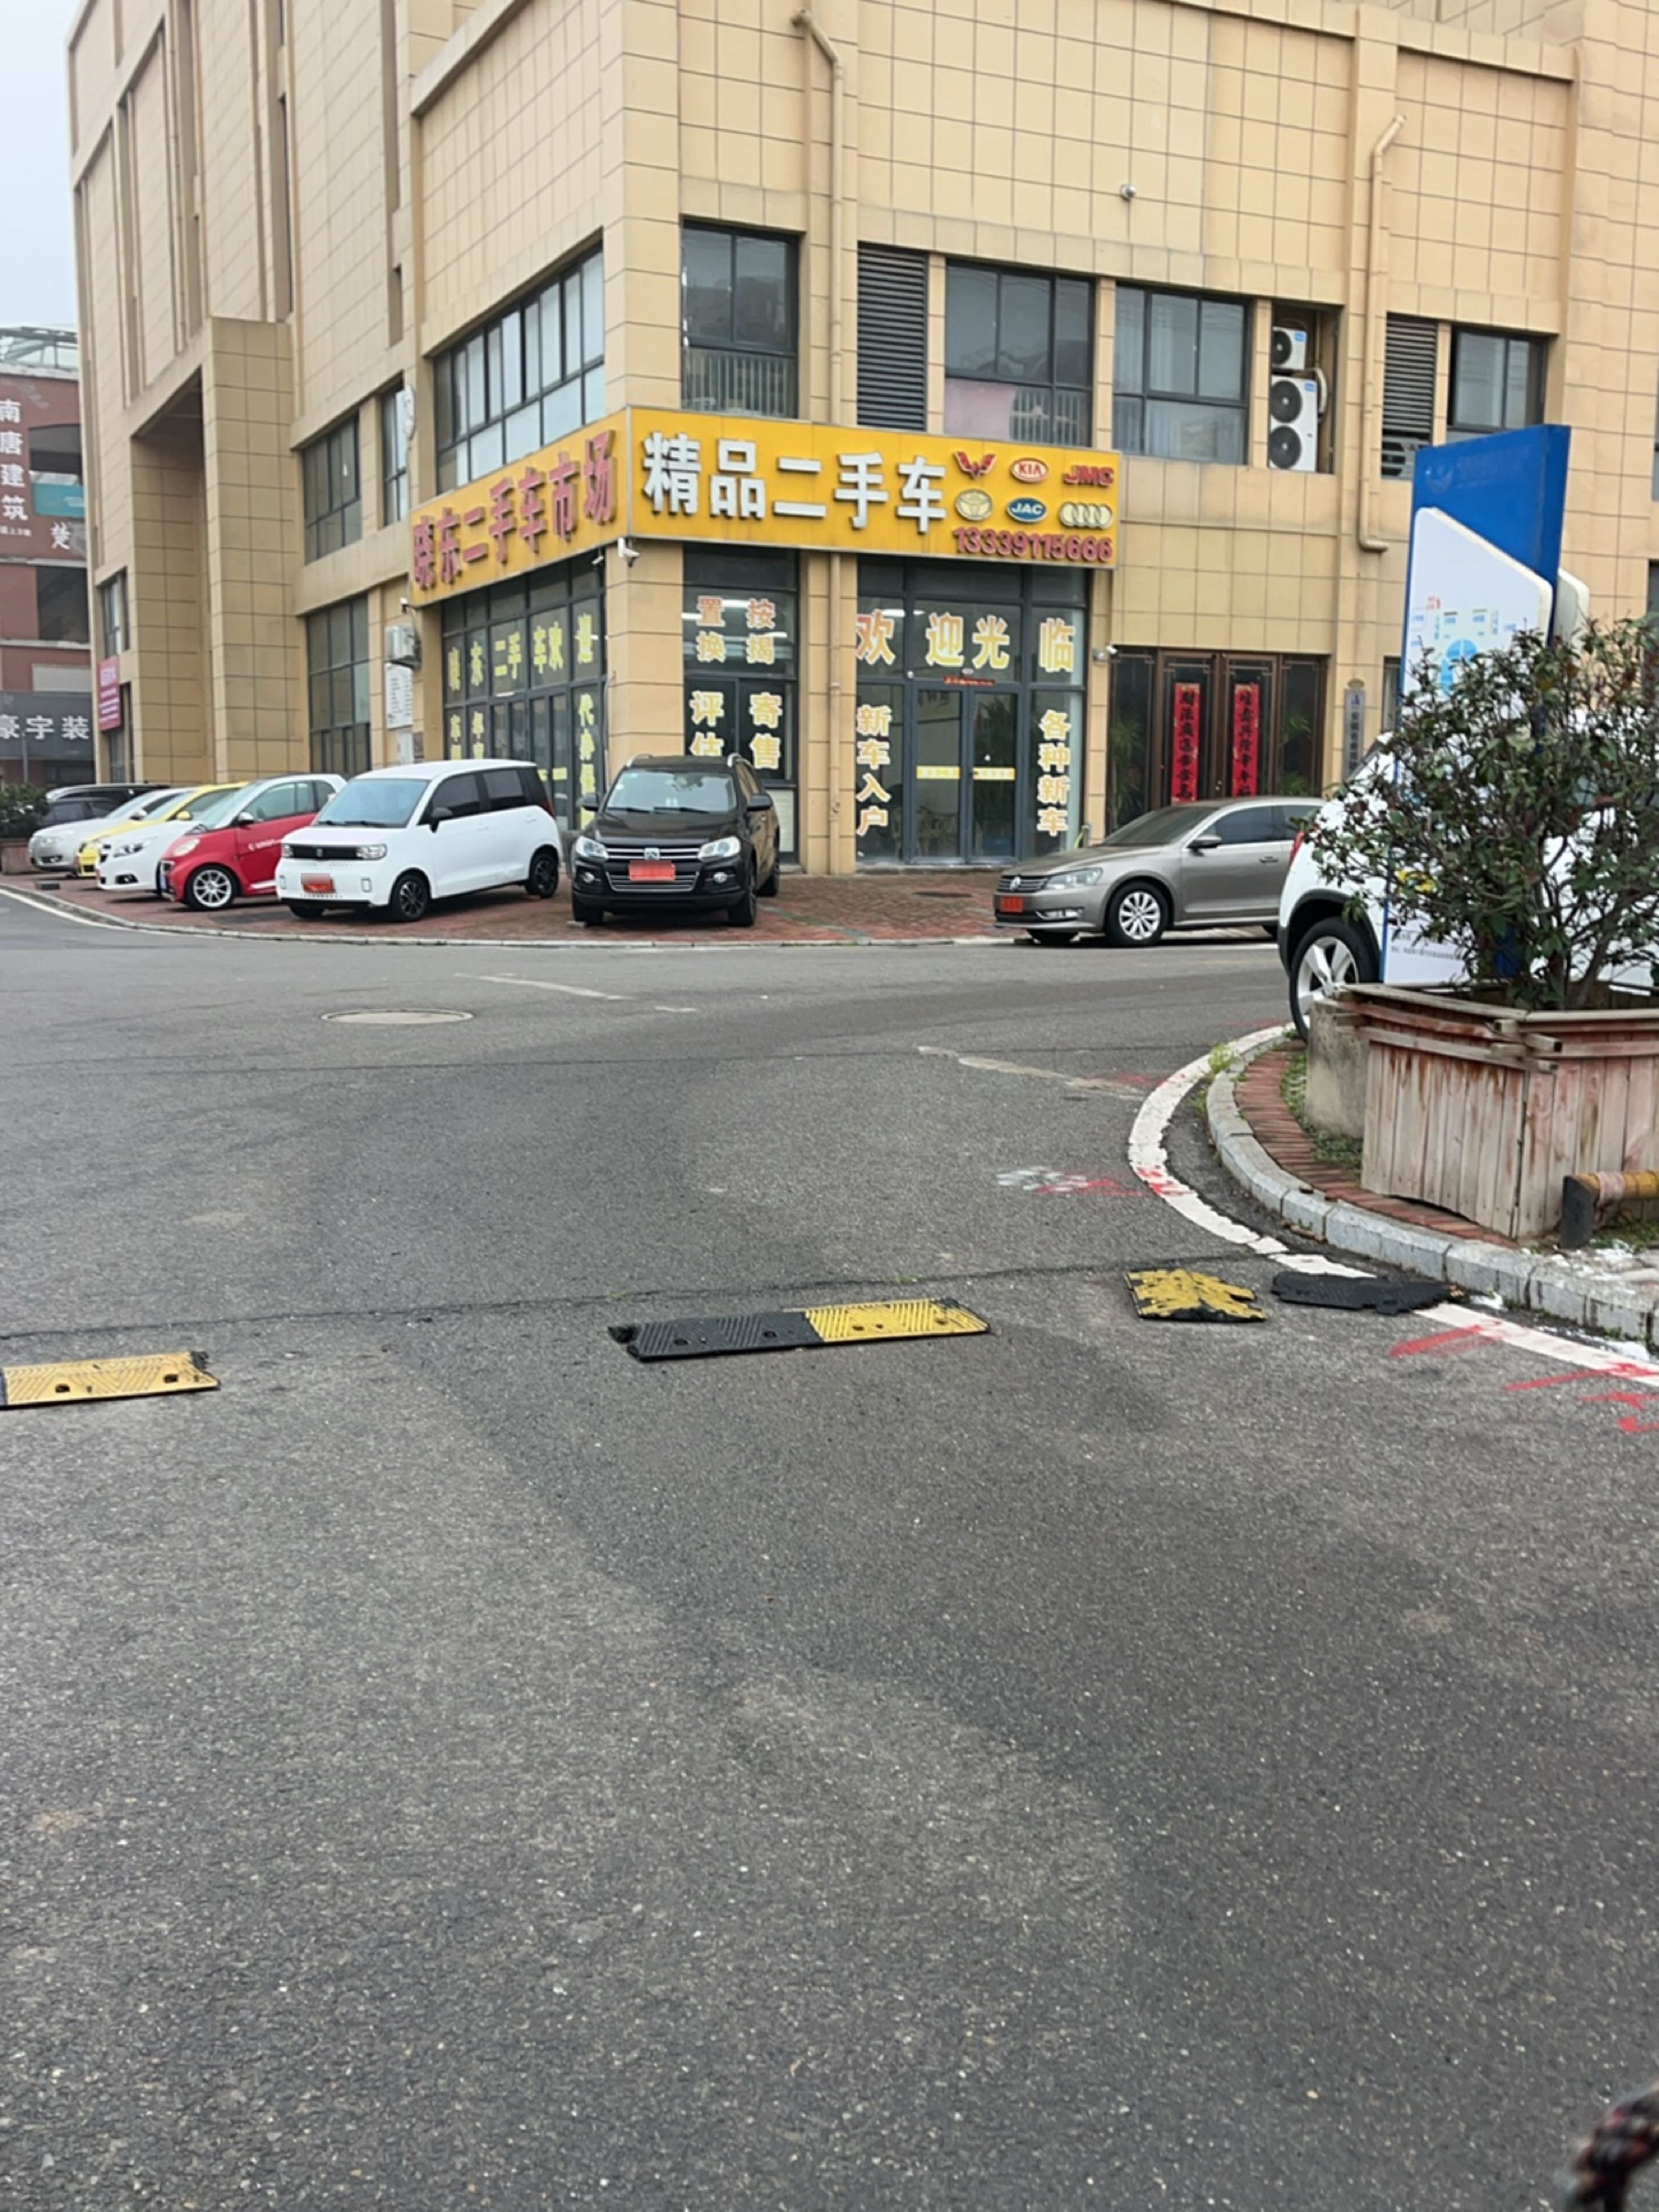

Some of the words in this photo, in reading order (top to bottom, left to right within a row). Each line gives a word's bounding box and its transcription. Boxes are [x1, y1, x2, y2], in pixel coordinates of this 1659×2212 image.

[643, 431, 947, 534] 精品二手车
[1063, 465, 1114, 486] JMC
[413, 430, 616, 590] 晓东二手车市场
[954, 526, 1112, 562] 13339115666
[696, 595, 725, 662] 置换
[746, 598, 775, 664] 按揭
[856, 609, 1076, 673] 欢迎光临
[689, 691, 725, 756] 评估
[749, 692, 783, 769] 寄售
[856, 705, 892, 835] 新车入户
[1037, 710, 1071, 837] 各种新车
